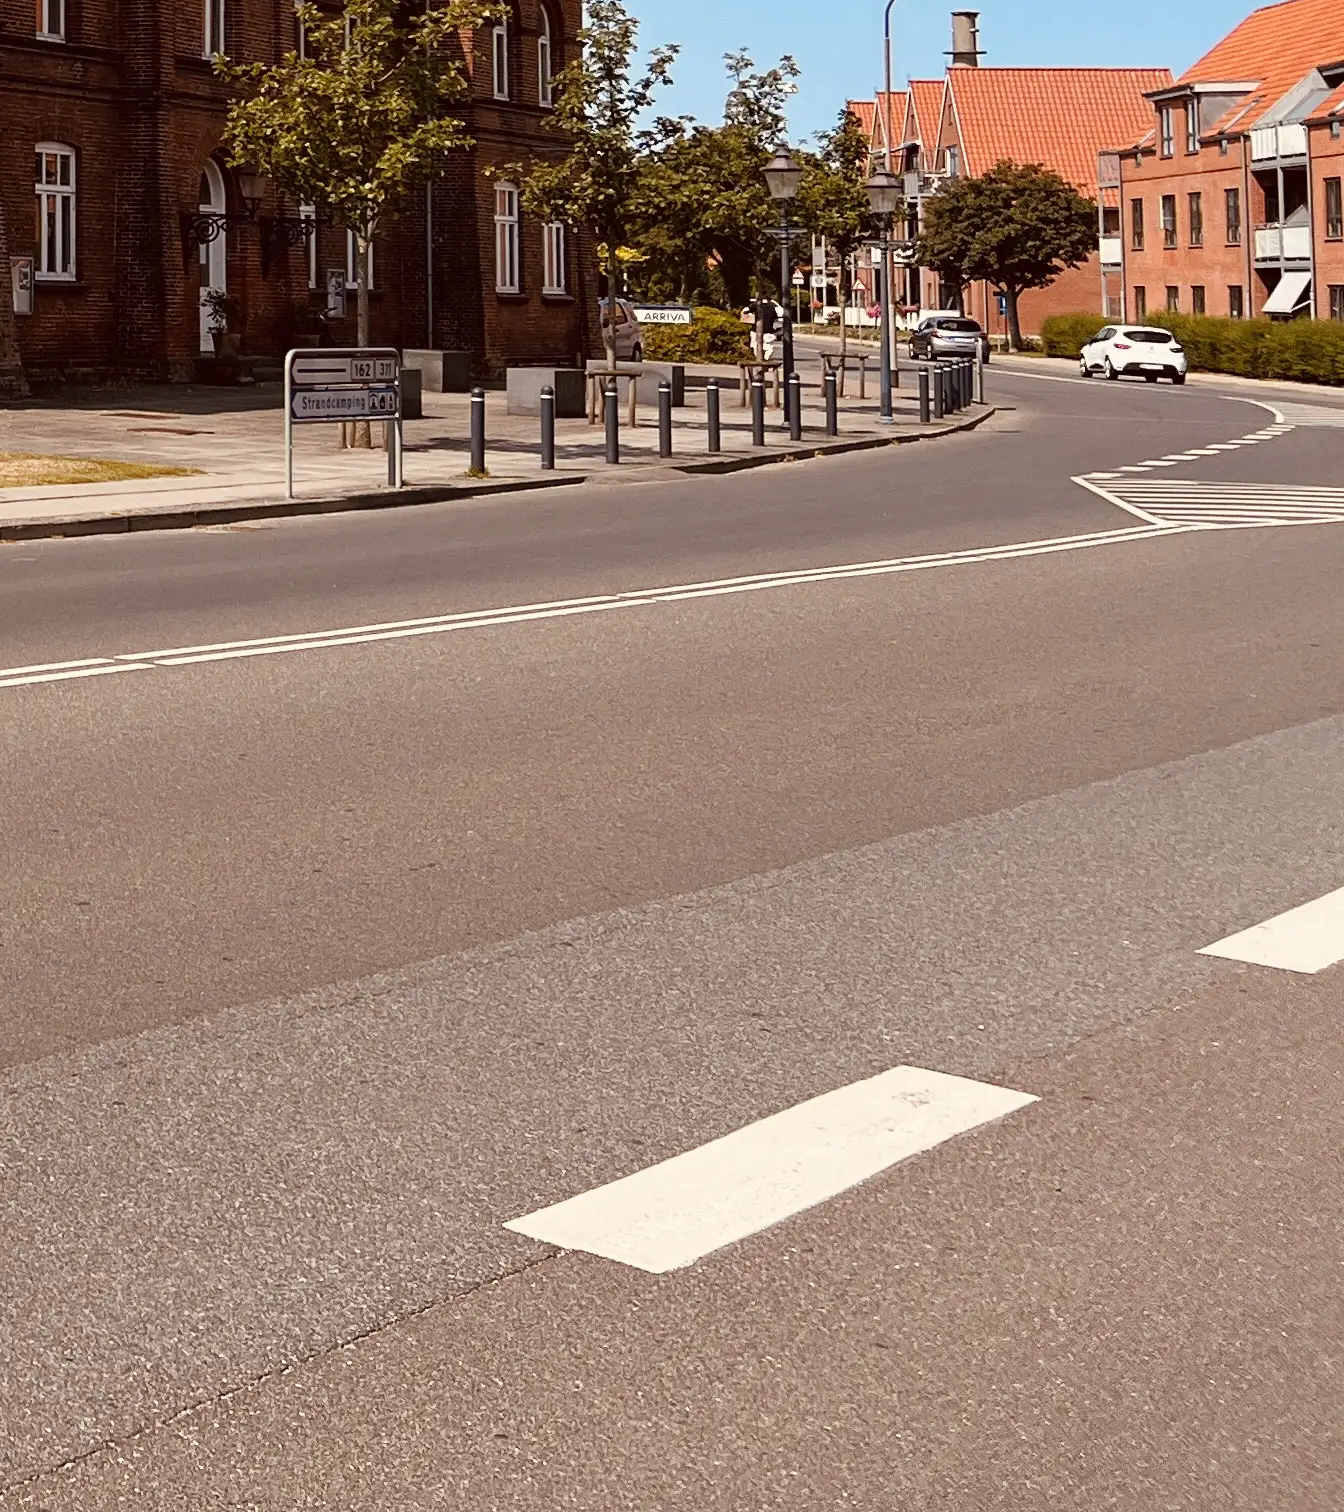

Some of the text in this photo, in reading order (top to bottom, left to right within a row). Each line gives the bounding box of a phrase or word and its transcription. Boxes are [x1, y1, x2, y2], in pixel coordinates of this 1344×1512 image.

[643, 312, 686, 322] ARRIVA
[354, 363, 372, 377] 162
[379, 362, 392, 376] 311
[301, 395, 366, 411] Strandcamping
